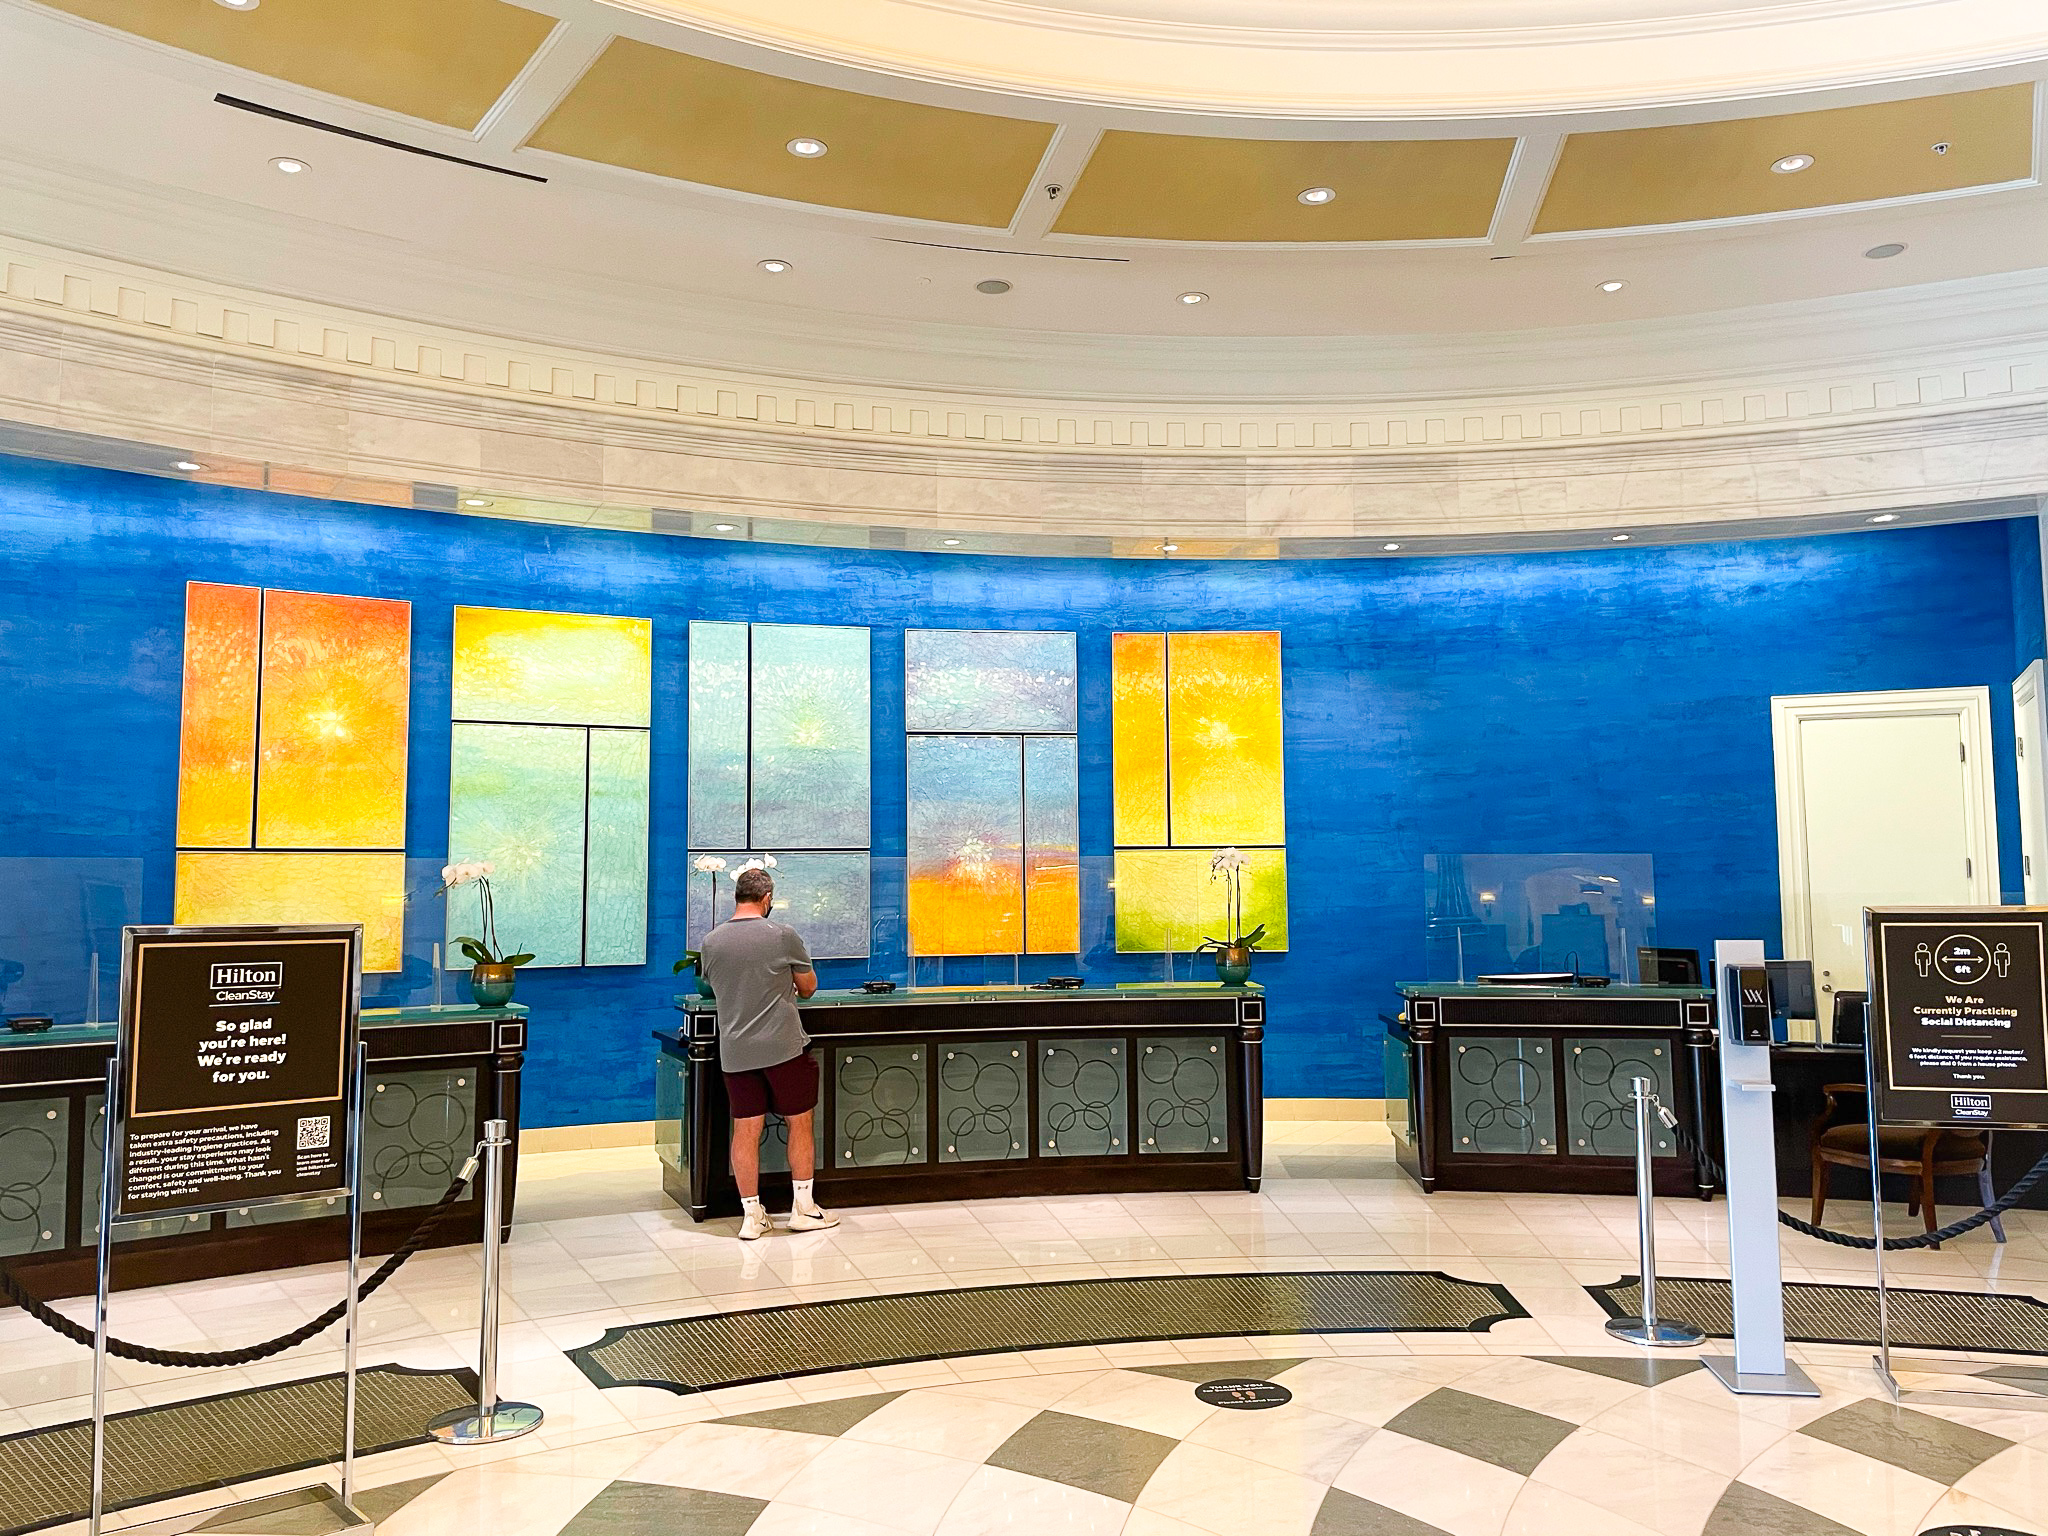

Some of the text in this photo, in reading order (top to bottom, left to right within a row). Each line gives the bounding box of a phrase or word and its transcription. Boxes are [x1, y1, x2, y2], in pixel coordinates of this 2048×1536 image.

[1954, 947, 1970, 955] 2m
[1955, 965, 1971, 974] 6ft
[217, 969, 276, 983] Hilton
[216, 990, 275, 1001] CleanStay
[1913, 1006, 2017, 1017] Currently Practicing
[216, 1018, 272, 1033] So glad
[1921, 1017, 2011, 1028] Social Distancing
[199, 1034, 286, 1052] you're here!
[197, 1050, 286, 1066] We're ready
[213, 1071, 270, 1083] for you.
[1954, 1097, 1988, 1106] Hilton
[1955, 1109, 1988, 1117] CleanStay
[141, 1132, 170, 1141] prepare
[193, 1143, 222, 1151] hygiene
[224, 1140, 259, 1149] practices.
[197, 1150, 237, 1159] experience
[129, 1166, 162, 1174] different
[129, 1174, 162, 1182] changed
[141, 1190, 169, 1198] staying
